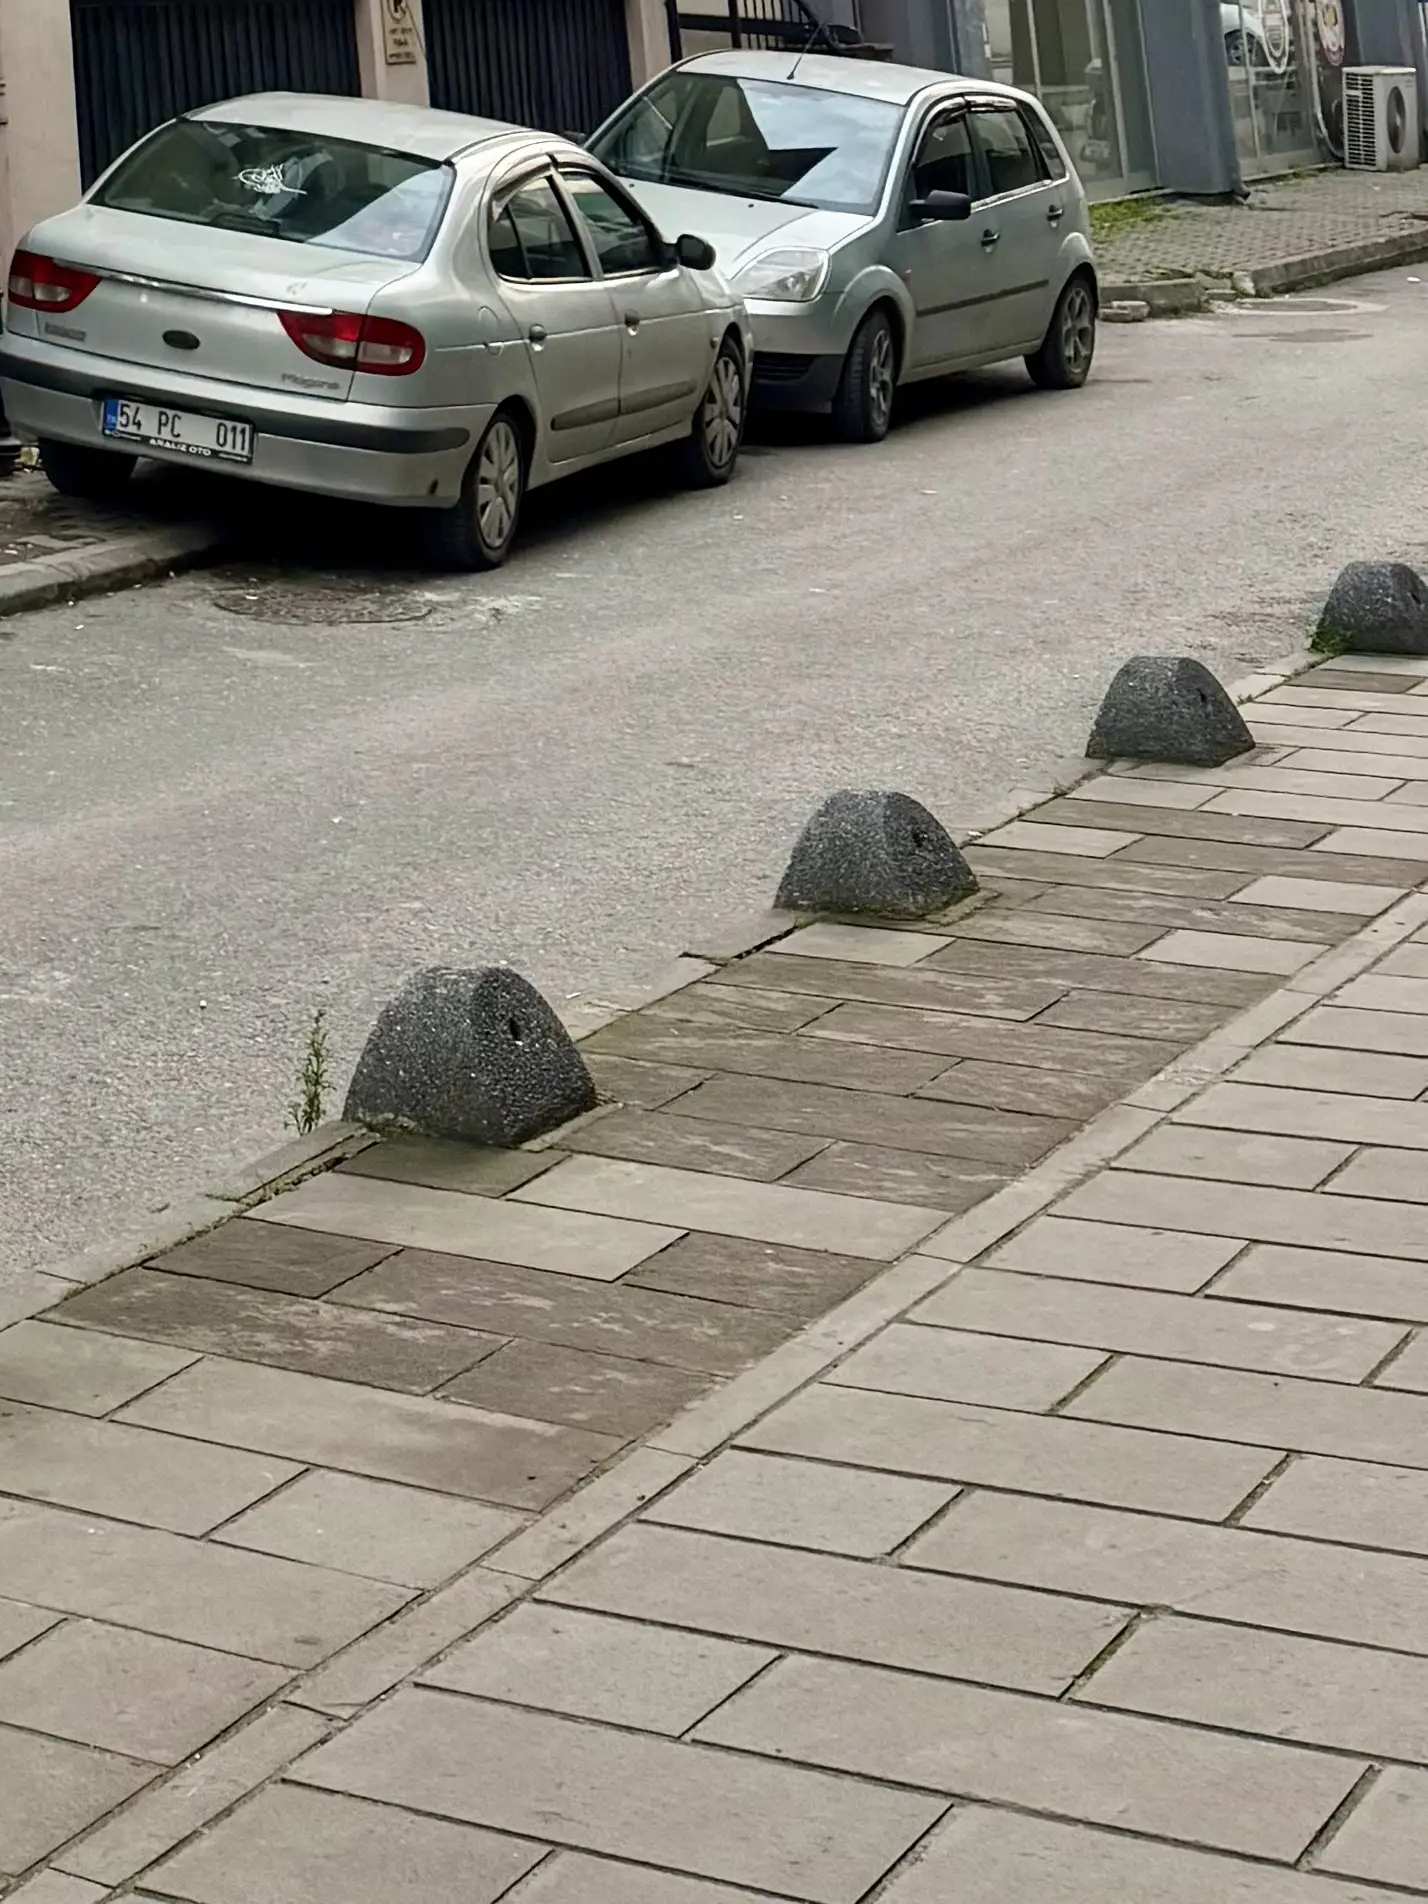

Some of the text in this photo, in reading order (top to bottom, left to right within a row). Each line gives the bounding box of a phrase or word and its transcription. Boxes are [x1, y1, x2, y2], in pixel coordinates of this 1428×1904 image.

[119, 403, 142, 432] 54
[157, 411, 182, 438] PC
[216, 422, 247, 451] 011
